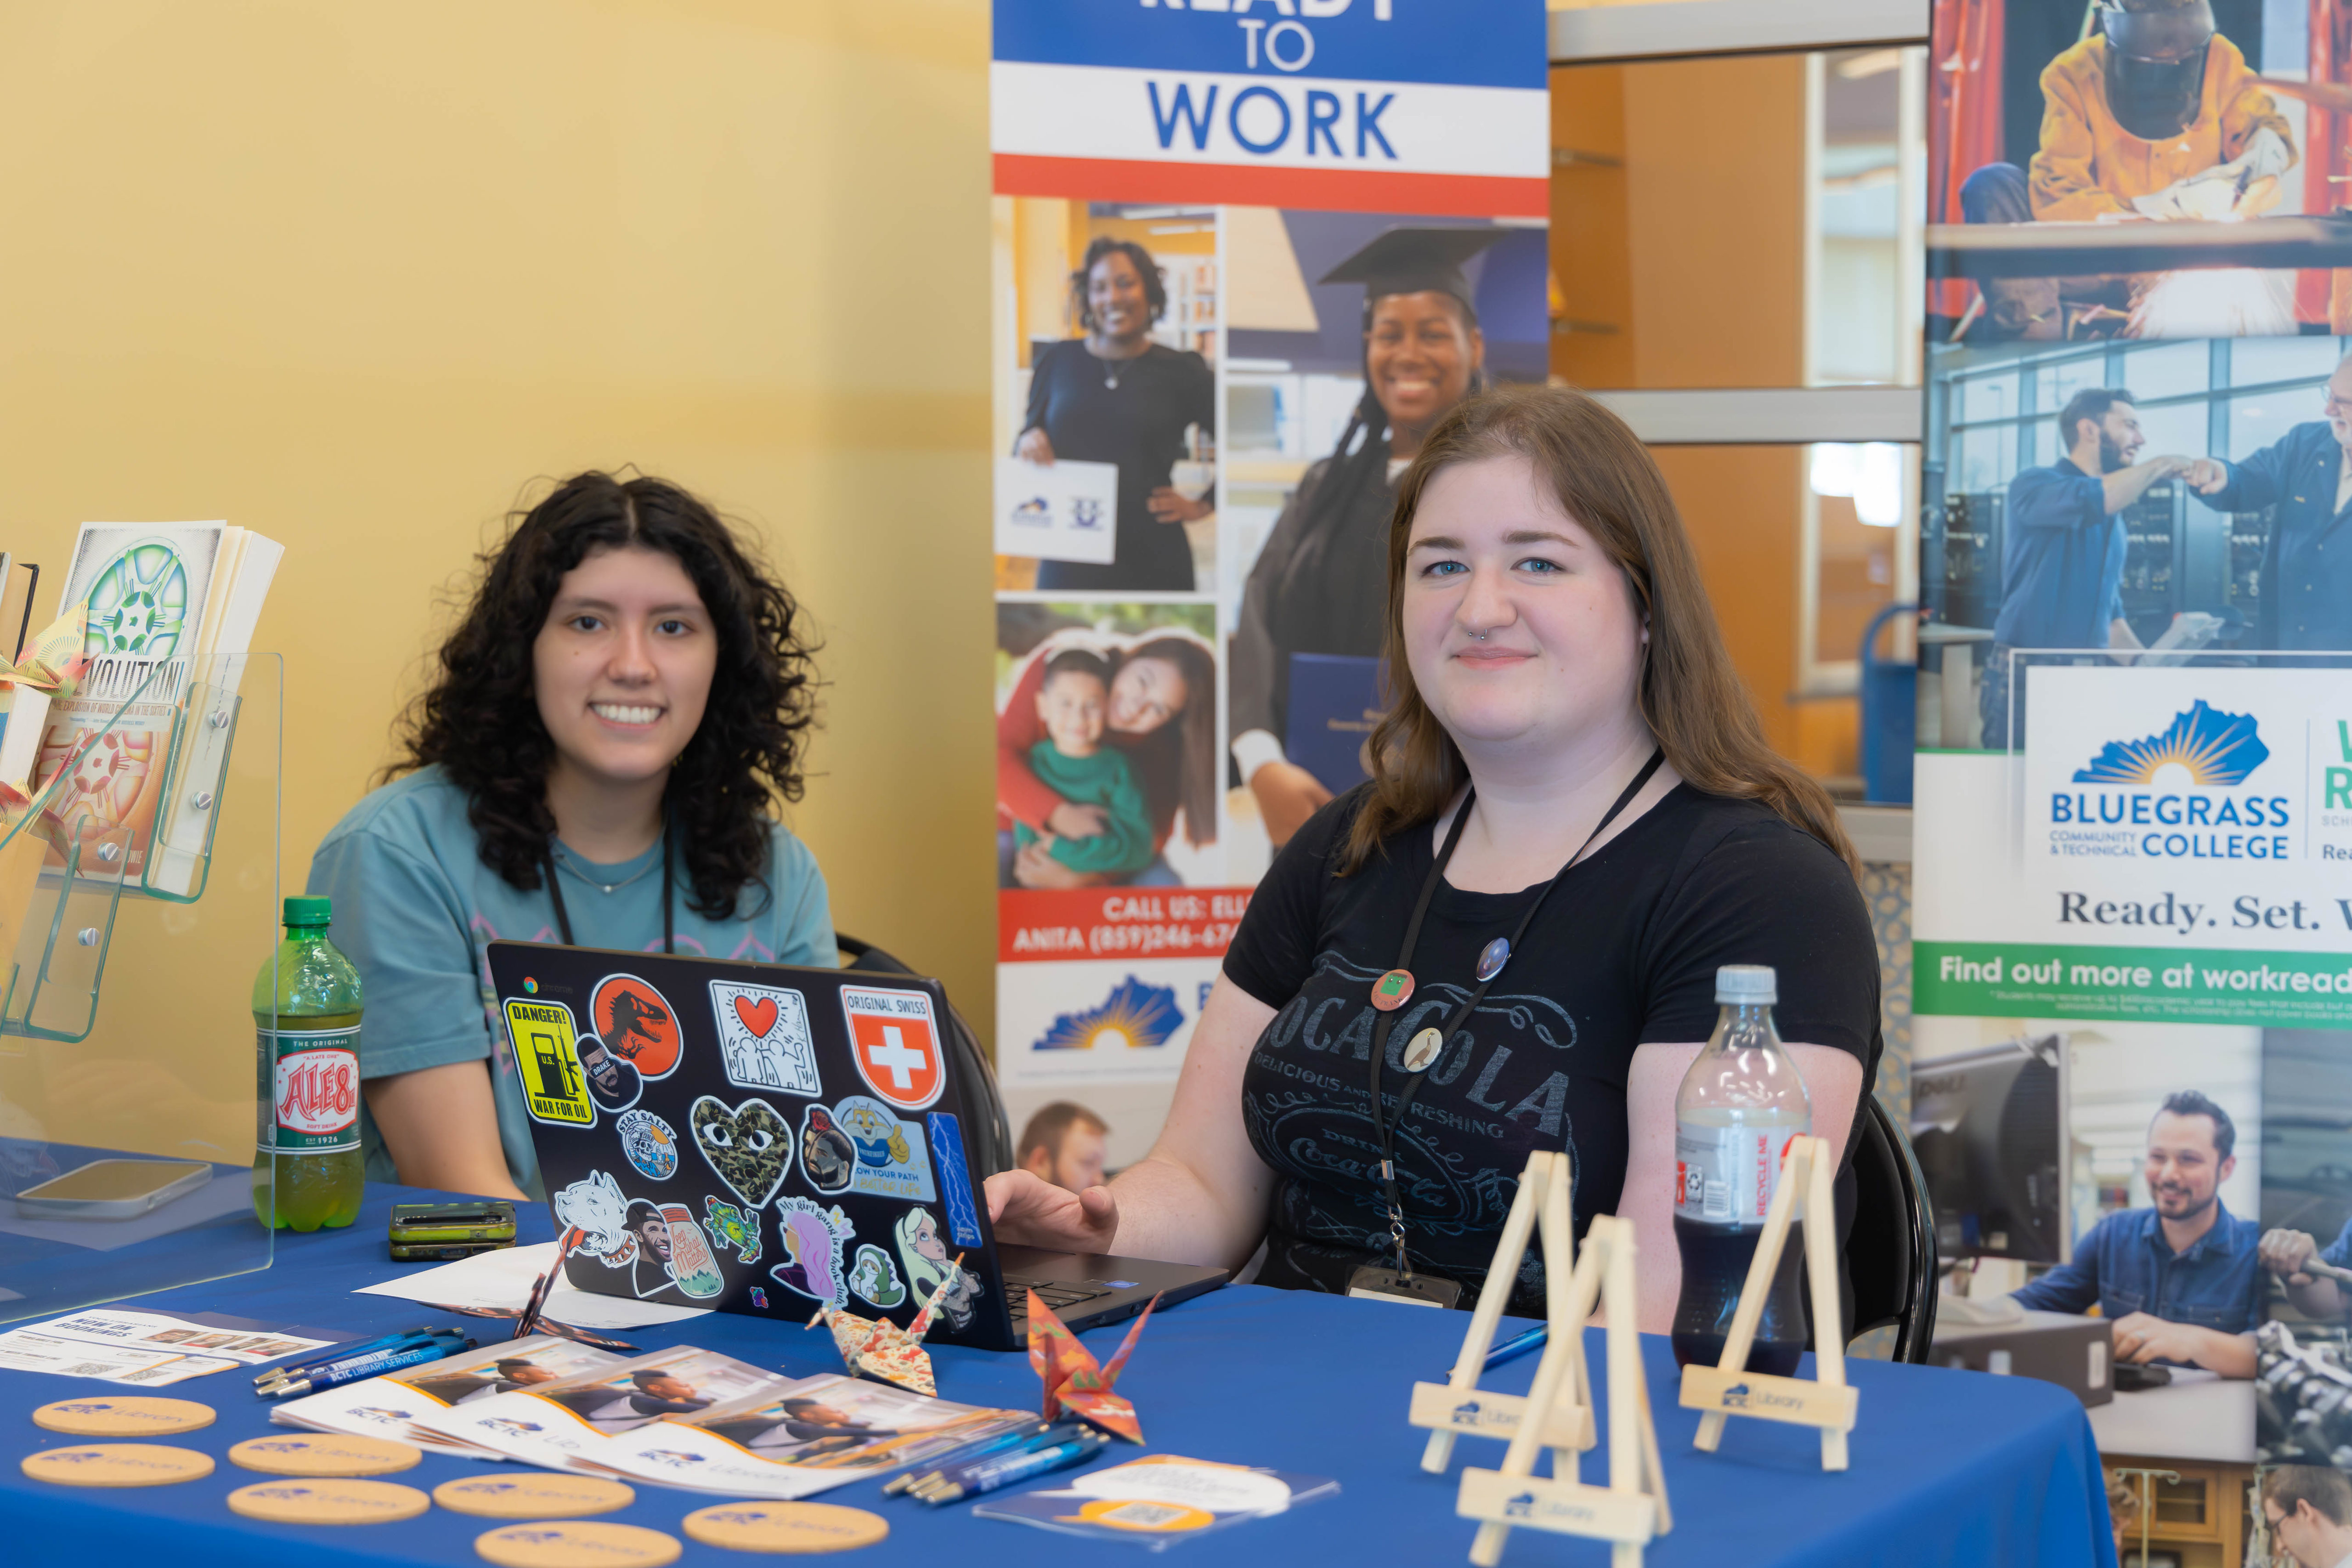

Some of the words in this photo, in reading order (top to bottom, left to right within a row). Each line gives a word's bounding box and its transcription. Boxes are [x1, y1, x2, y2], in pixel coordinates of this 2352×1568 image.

[1237, 19, 1315, 72] TO
[1145, 81, 1400, 160] WORK
[90, 702, 98, 713] OF
[97, 703, 115, 714] WORLD
[116, 704, 136, 715] CIMA
[141, 705, 150, 716] THE
[149, 706, 167, 716] SIXTIES
[2051, 792, 2290, 827] BLUEGRASS
[2049, 829, 2137, 843] COMMUNITY
[2049, 844, 2058, 855] &
[2062, 844, 2137, 857] TECHNICAL
[2142, 832, 2289, 860] COLLEGE
[1102, 896, 1165, 922] CALL
[1169, 895, 1207, 920] US:
[1211, 894, 1254, 919] ELL
[2056, 891, 2217, 935] Ready.
[2231, 894, 2320, 931] Set.
[1012, 926, 1086, 952] ANITA
[1939, 956, 2003, 984] Find
[2011, 960, 2062, 986] out
[2070, 963, 2153, 987] more
[2161, 963, 2194, 989] at
[847, 995, 893, 1011] ORIGINAL
[896, 999, 927, 1014] SWISS
[512, 1005, 567, 1025] DANGER!
[312, 1038, 348, 1047] ORIGINAL
[541, 1055, 555, 1066] U.S.
[593, 1059, 611, 1076] DRAKE
[1385, 1000, 1570, 1137] COLA
[1255, 1051, 1341, 1092] DELICIOUS
[1380, 1092, 1504, 1138] RERESHING
[533, 1098, 555, 1115] WAR
[556, 1101, 573, 1117] FOR
[574, 1104, 588, 1119] OIL
[618, 1112, 638, 1133] STAY
[641, 1113, 675, 1138] SALTY
[317, 1136, 338, 1144] 1926
[1758, 1134, 1768, 1155] ME
[855, 1167, 871, 1176] OW
[872, 1169, 896, 1179] YOUR
[898, 1172, 919, 1182] PATH
[1757, 1158, 1767, 1217] RECYCLE
[780, 1200, 794, 1211] My
[797, 1200, 815, 1213] girl
[815, 1210, 838, 1236] gang
[831, 1237, 840, 1246] is
[830, 1255, 841, 1281] book
[53, 1322, 133, 1337] BOOKINGS
[71, 1318, 113, 1327] NOW
[351, 1361, 386, 1376] LIBRARY
[367, 1352, 424, 1368] SERVICES
[329, 1369, 353, 1382] BCTC
[1756, 1391, 1804, 1411] Library
[113, 1410, 191, 1422] Library
[345, 1408, 399, 1424] BCTC
[476, 1419, 529, 1438] BCTC
[637, 1450, 692, 1469] BCTC
